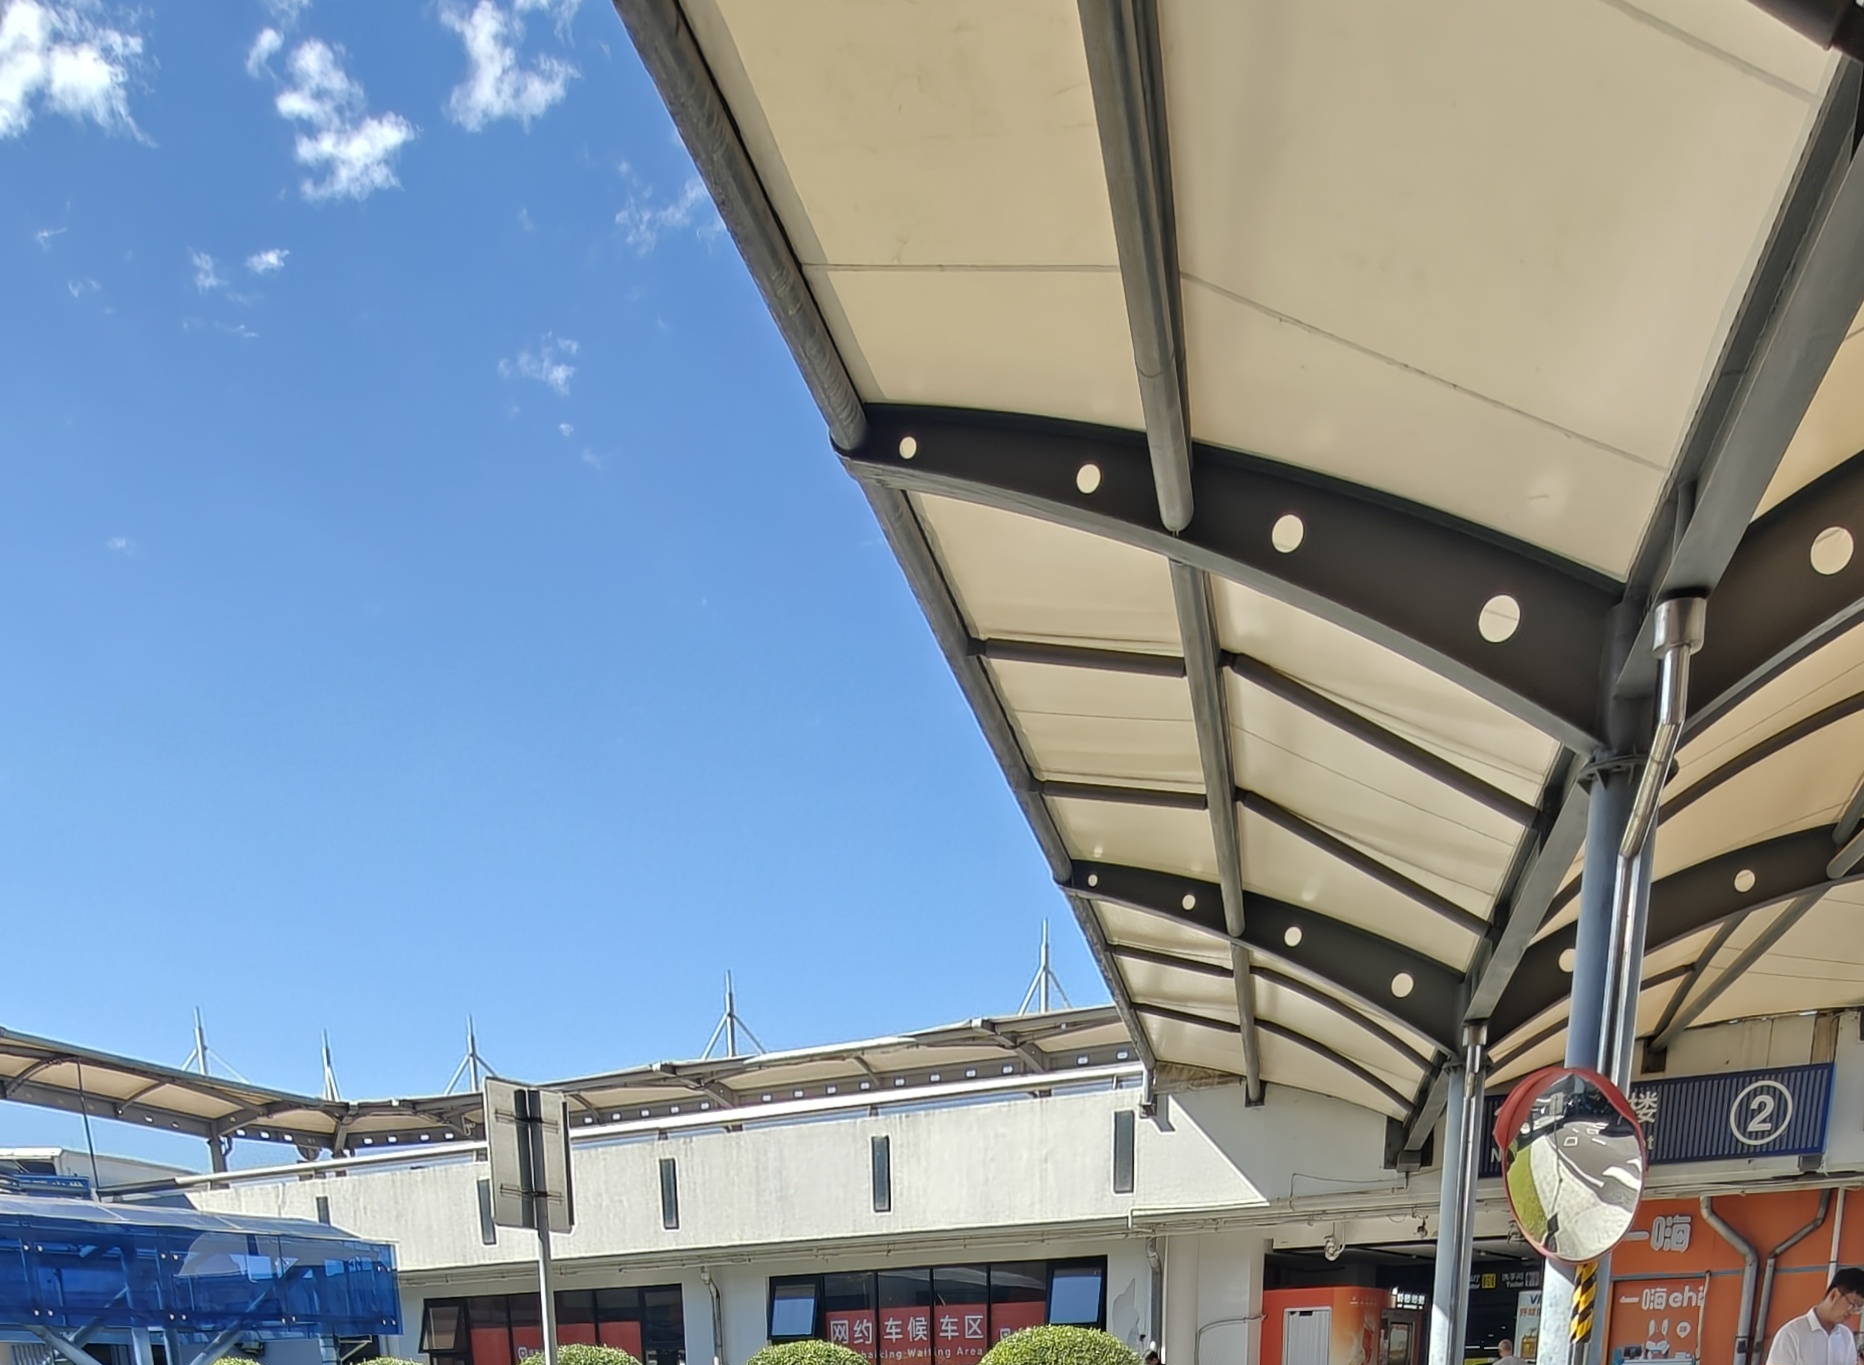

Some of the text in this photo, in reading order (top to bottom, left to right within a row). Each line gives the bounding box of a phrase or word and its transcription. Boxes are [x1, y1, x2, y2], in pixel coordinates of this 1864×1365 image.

[829, 1315, 984, 1345] 网约车候车区
[956, 1346, 983, 1356] Area
